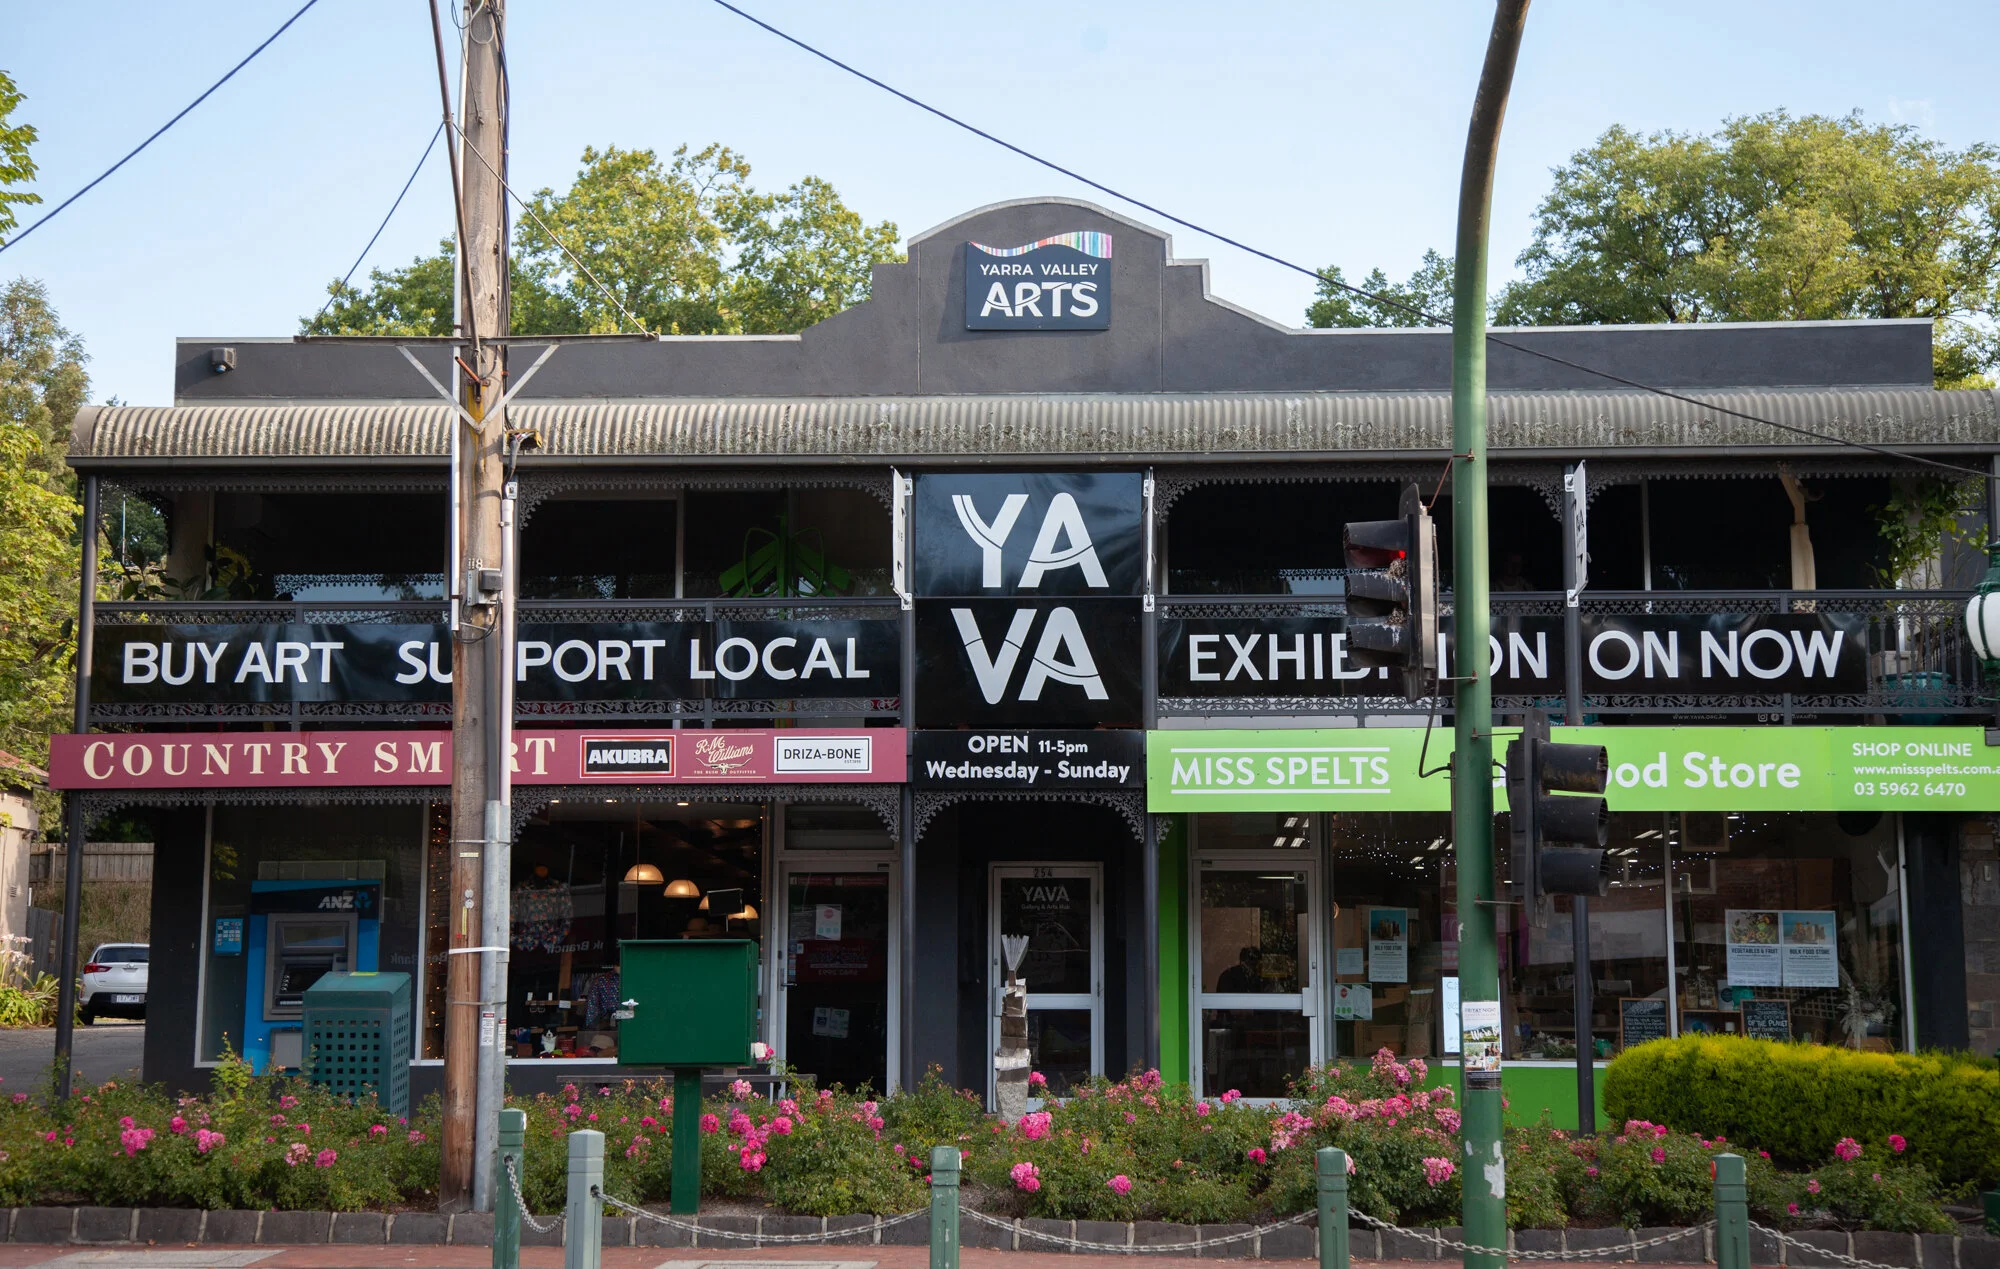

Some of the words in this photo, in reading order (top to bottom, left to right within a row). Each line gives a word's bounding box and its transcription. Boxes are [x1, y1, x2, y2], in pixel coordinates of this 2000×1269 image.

[980, 264, 1033, 275] YARRA
[1040, 263, 1099, 275] VALLEY
[980, 281, 1099, 317] ARTS
[951, 492, 1110, 588] YA
[122, 641, 229, 686] BUY
[233, 641, 344, 684] ART
[395, 639, 666, 684] SUPORT
[690, 637, 870, 681] LOCAL
[950, 606, 1110, 704] VA
[1588, 629, 1679, 680] ON
[1701, 629, 1844, 680] NOW
[708, 744, 754, 763] Williams
[784, 748, 861, 759] DRIZA-BONE
[967, 735, 1029, 753] OPEN
[1038, 740, 1088, 756] 11-5pm
[1852, 742, 1901, 756] SHOP
[1905, 742, 1973, 757] ONLINE
[83, 741, 347, 780] COUNTRY
[587, 749, 669, 764] AKUBRA
[926, 760, 1039, 783] Wednesday
[1057, 760, 1130, 783] Sunday
[1171, 756, 1255, 786] MISS
[1266, 756, 1390, 785] SPELTS
[1683, 751, 1801, 788] Store
[1854, 782, 1875, 796] 03
[1880, 782, 1919, 796] 5962
[1924, 782, 1966, 796] 6470
[1034, 868, 1052, 878] 254
[318, 895, 354, 909] ANZ
[1021, 885, 1070, 902] YAVA
